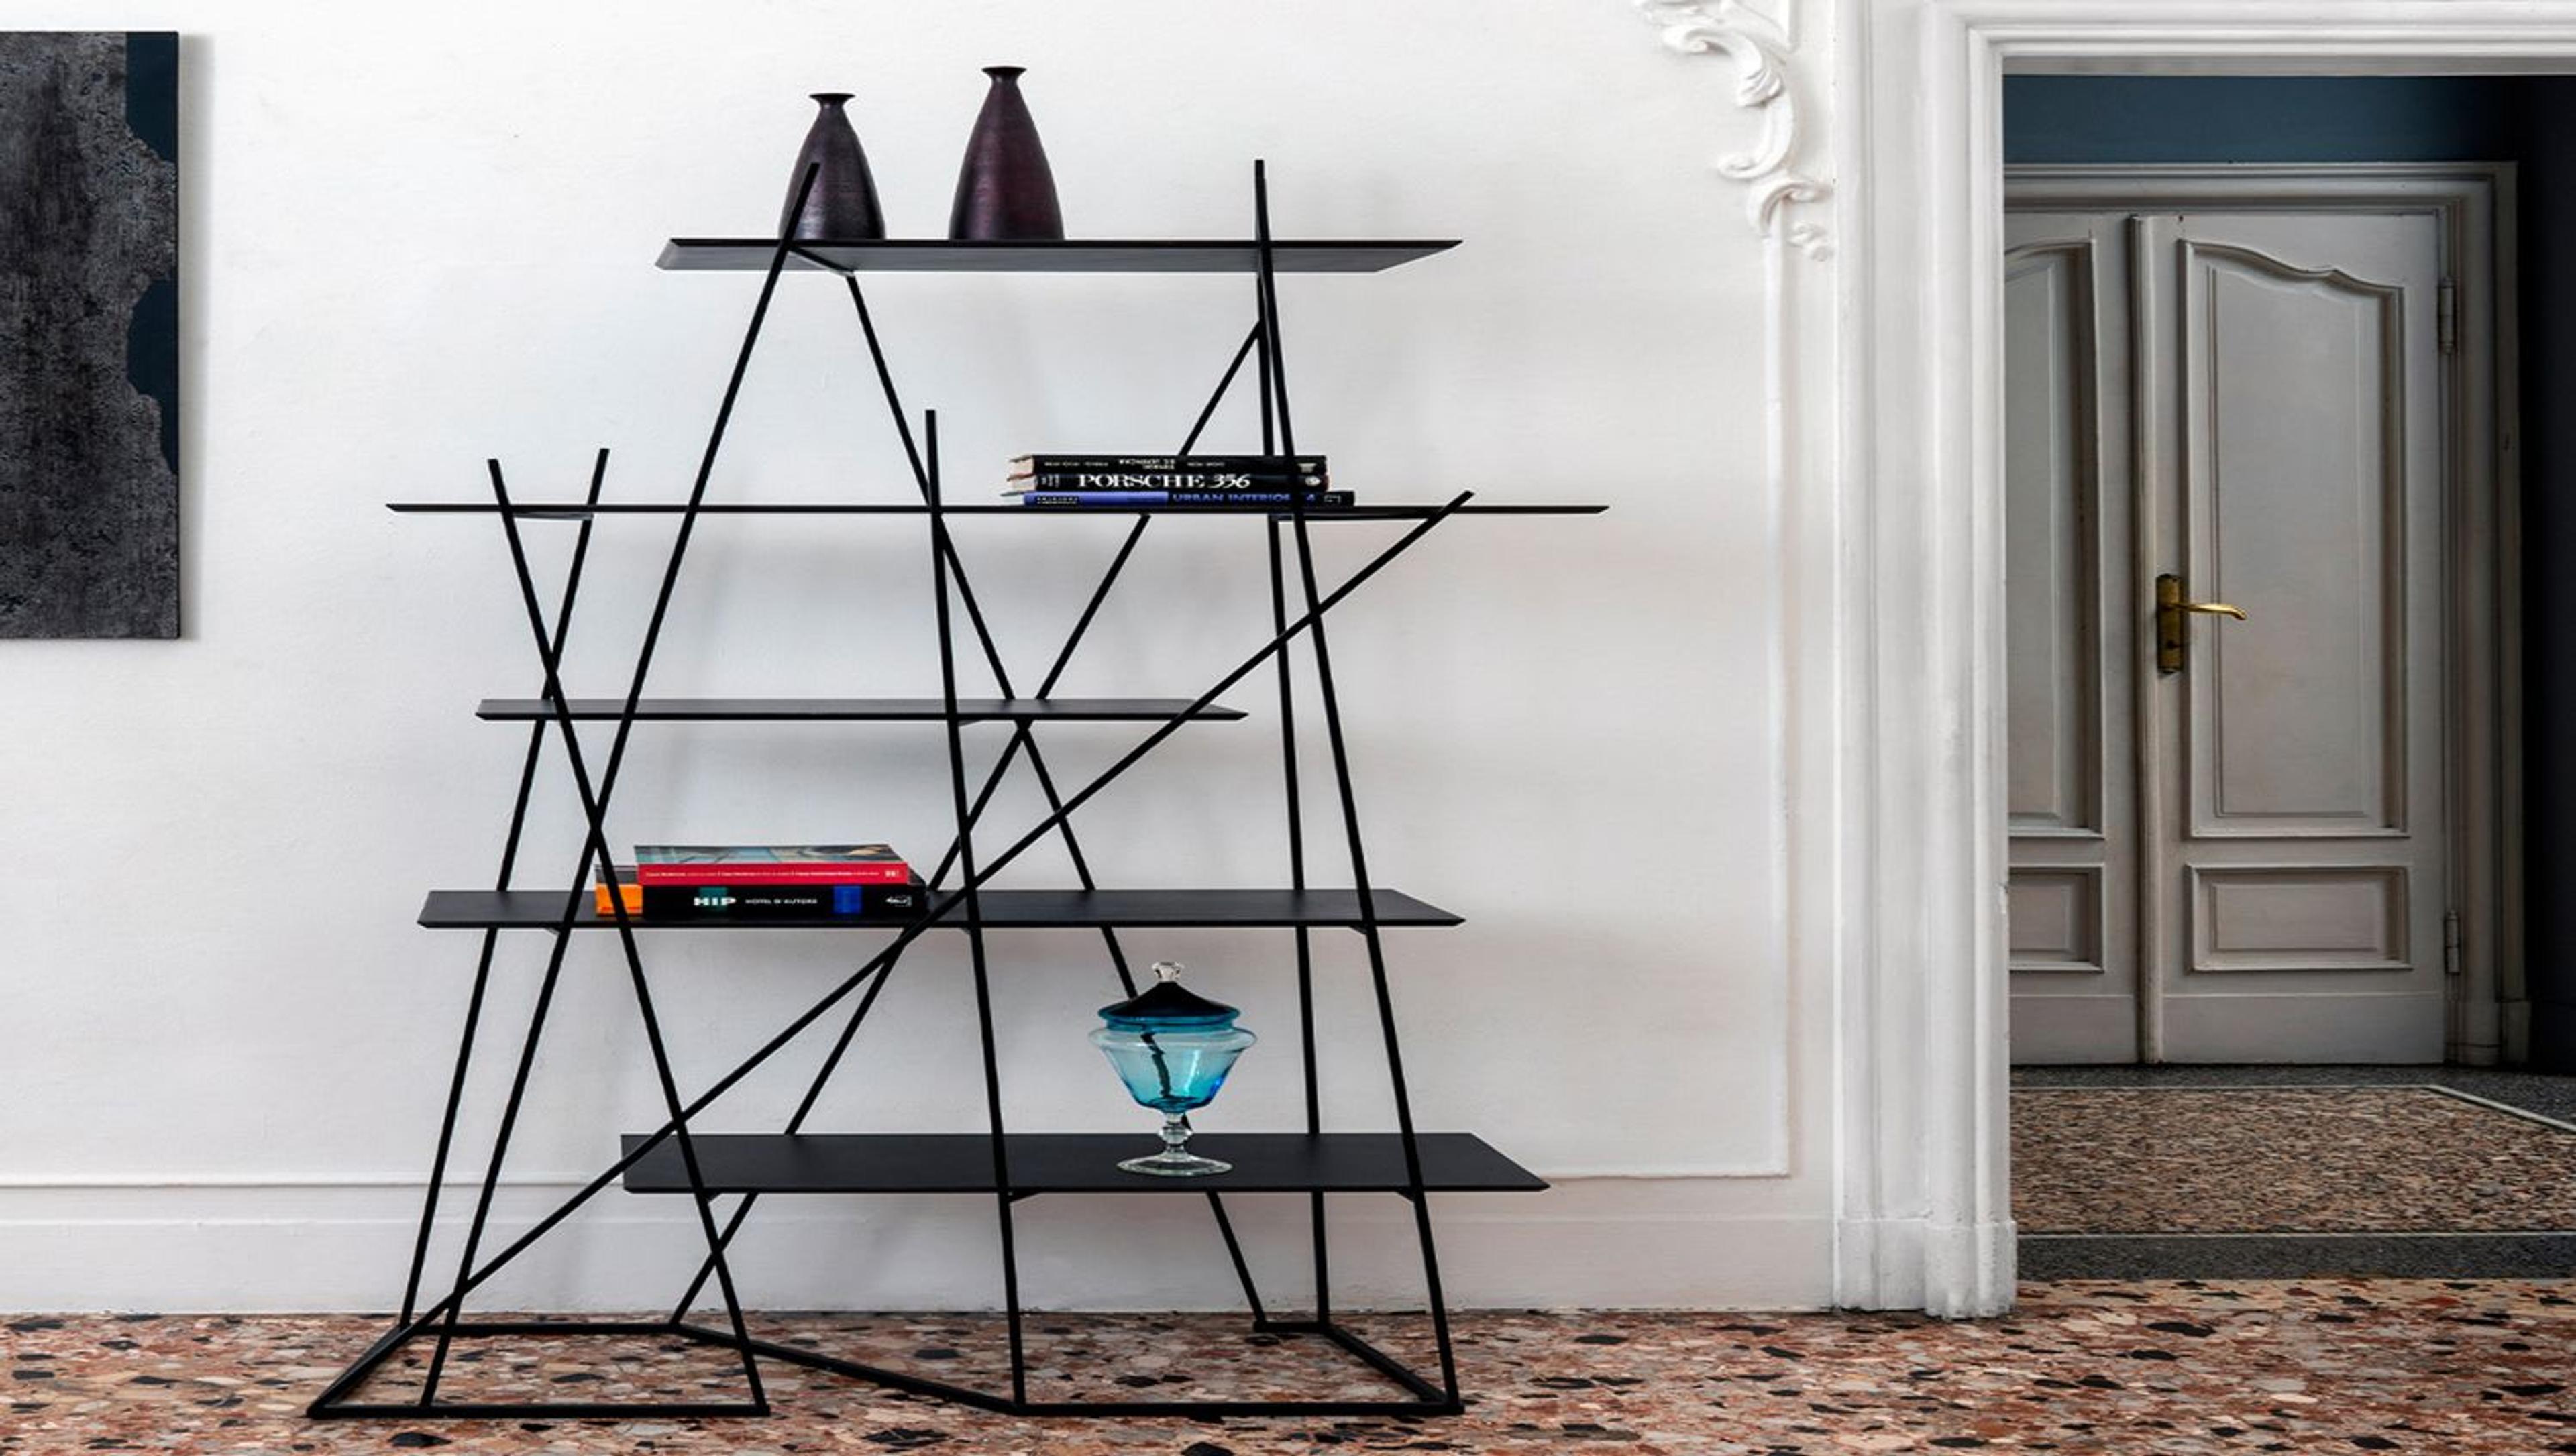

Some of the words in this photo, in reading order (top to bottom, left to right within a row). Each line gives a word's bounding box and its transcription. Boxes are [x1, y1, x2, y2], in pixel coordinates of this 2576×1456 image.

[1078, 473, 1205, 488] PORSCHE
[1209, 473, 1251, 488] 356
[1173, 493, 1224, 502] URBAN
[694, 897, 737, 906] HIP
